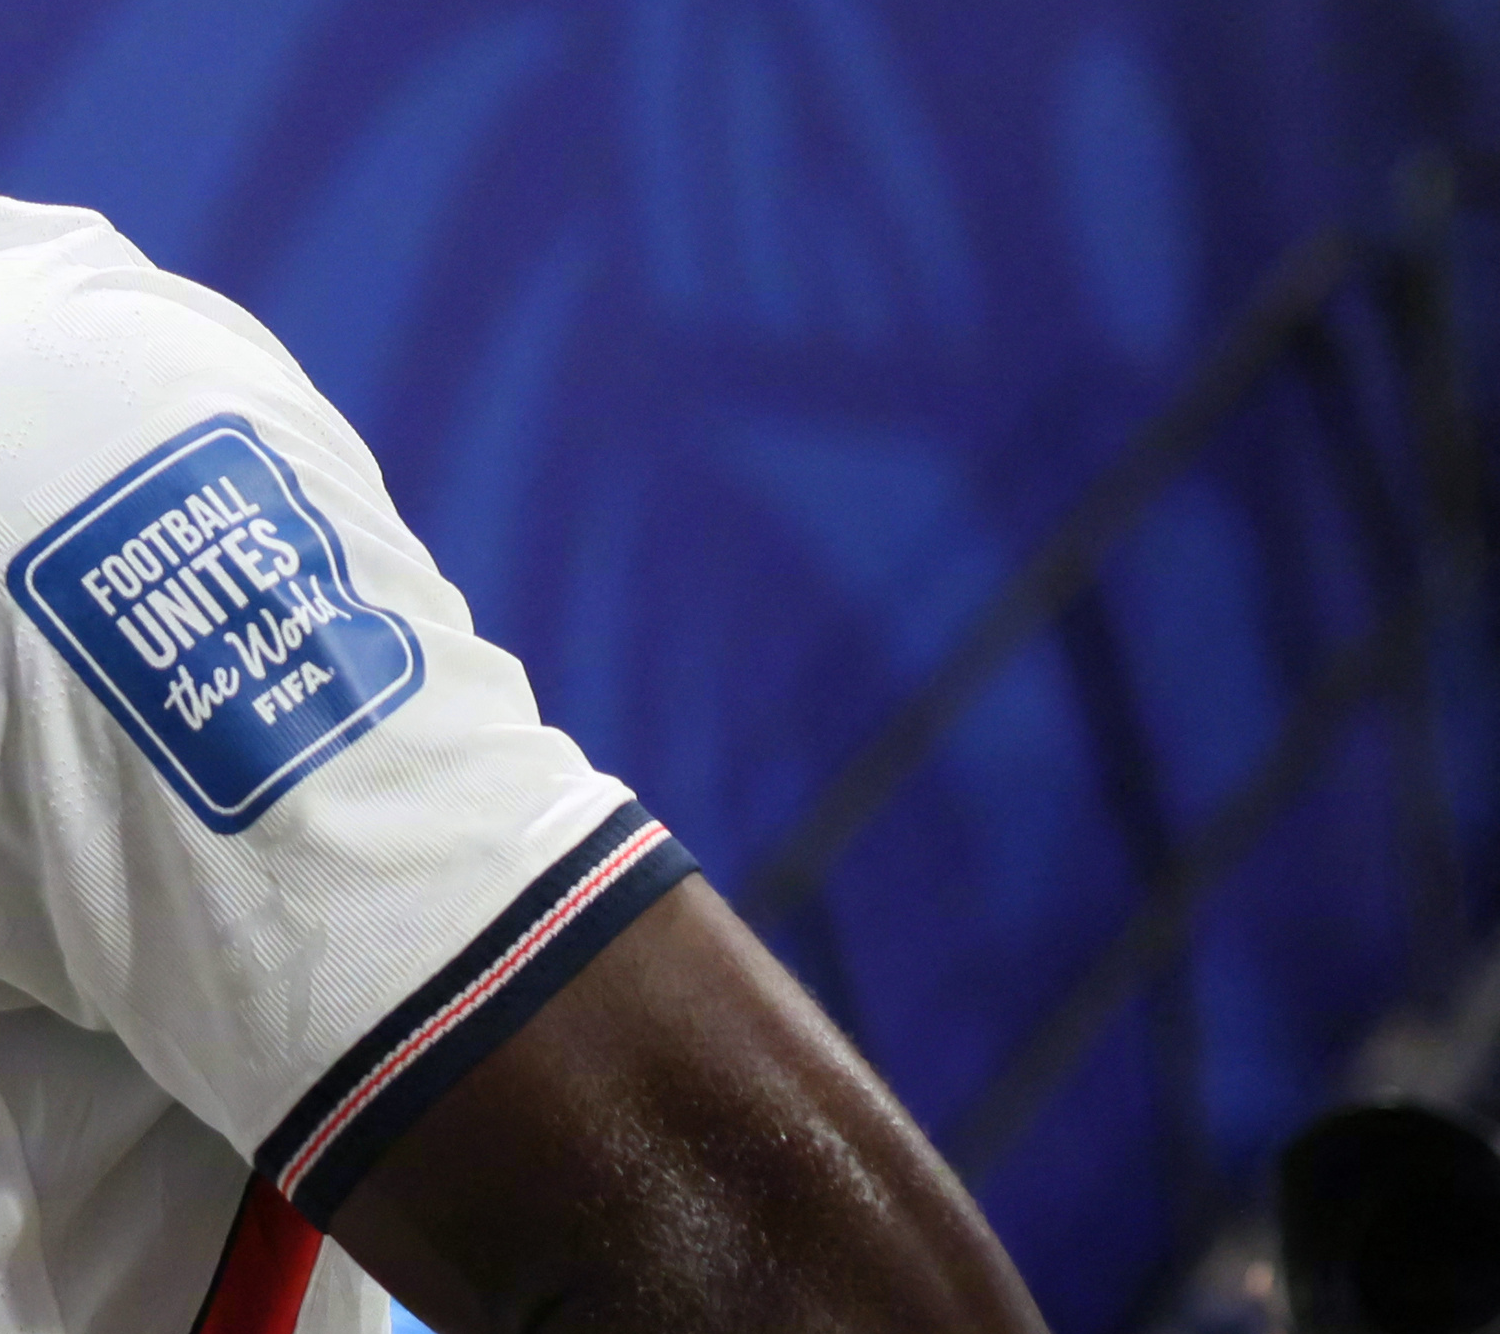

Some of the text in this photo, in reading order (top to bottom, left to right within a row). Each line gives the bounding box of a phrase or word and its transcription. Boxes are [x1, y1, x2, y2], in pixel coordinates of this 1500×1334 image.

[80, 475, 261, 616] FOOTBALL
[115, 518, 301, 669] UNITES
[163, 574, 352, 730] the World
[251, 660, 330, 725] FIFA
